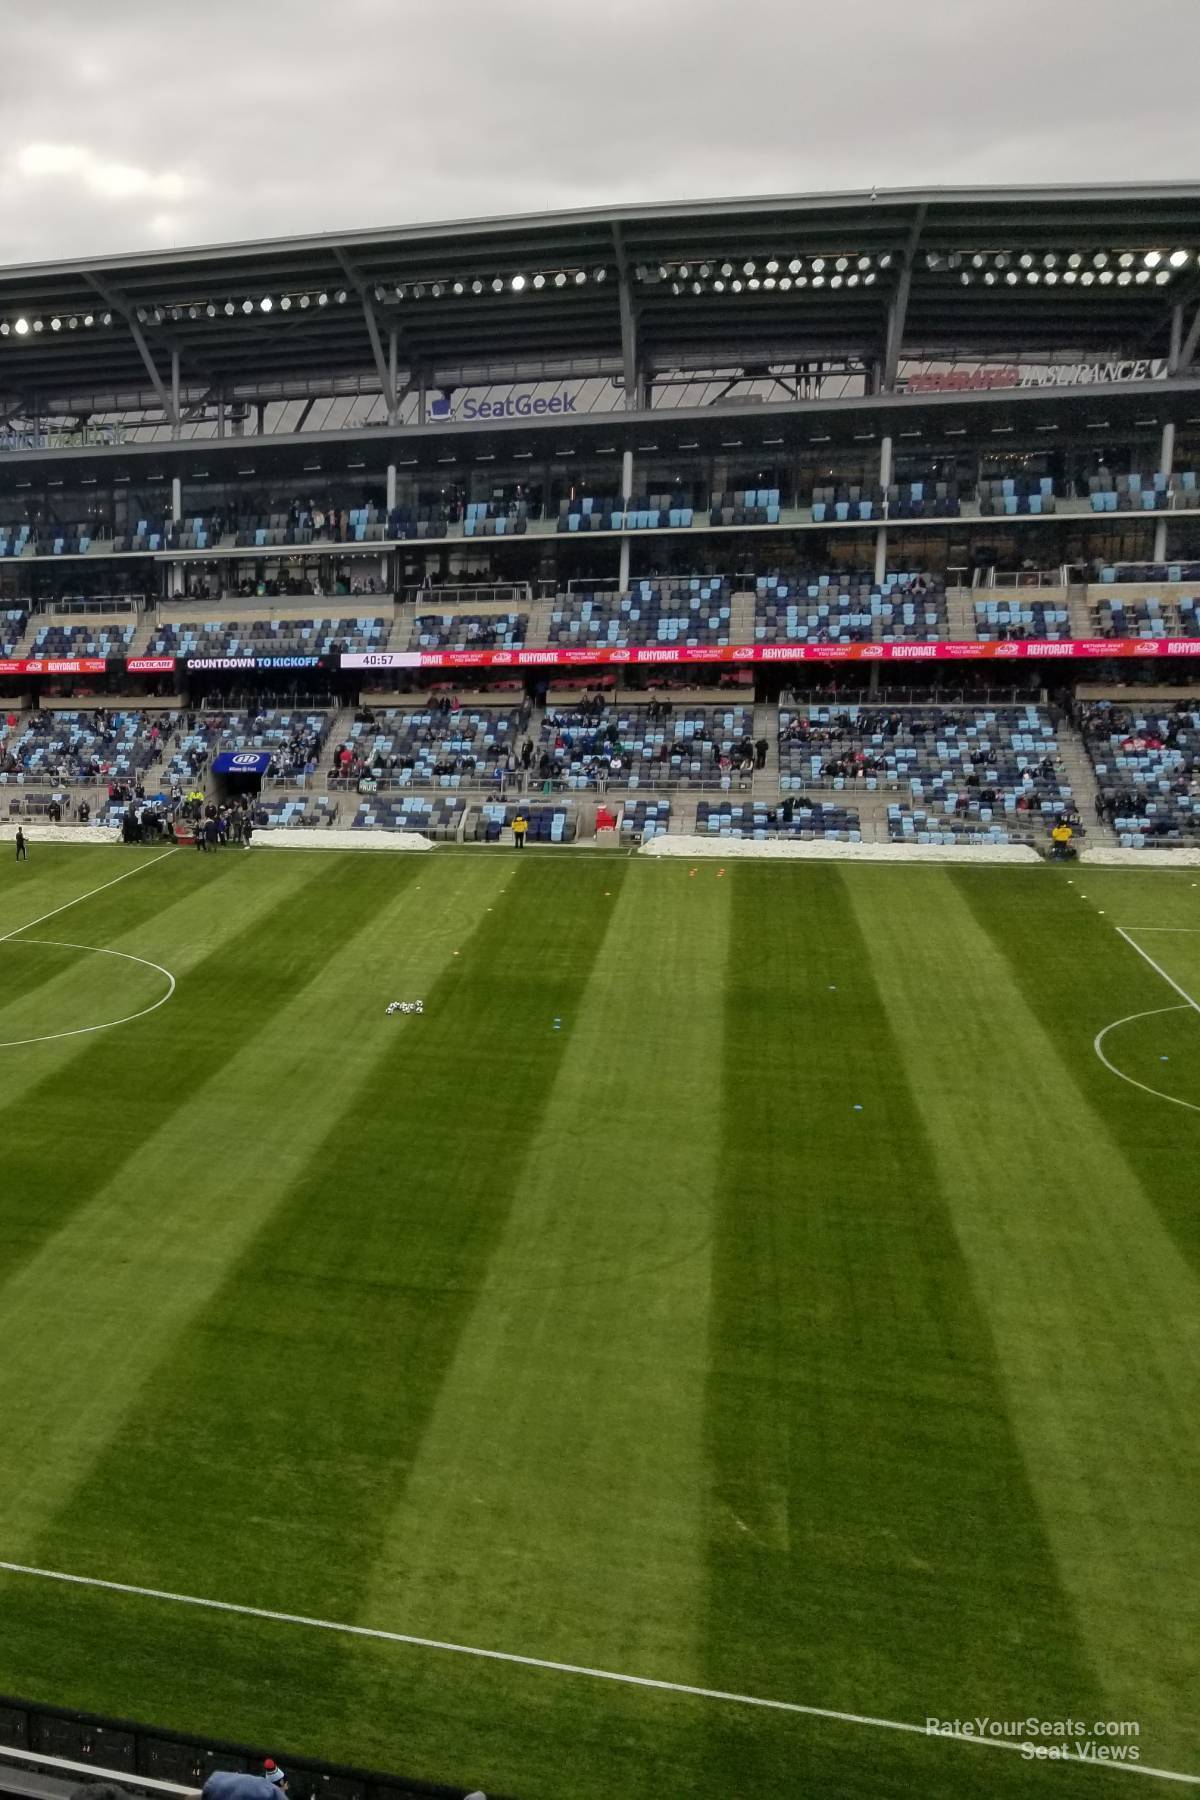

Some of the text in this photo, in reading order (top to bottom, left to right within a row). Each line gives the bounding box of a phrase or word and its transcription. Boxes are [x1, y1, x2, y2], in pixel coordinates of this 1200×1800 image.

[1020, 360, 1149, 387] INSURANCE
[463, 392, 576, 419] SeatGeek
[762, 648, 805, 658] REHYDRATE
[892, 646, 937, 656] REHYDRATE
[1027, 643, 1074, 655] REHYDRATE
[362, 656, 394, 665] 40:57
[519, 652, 559, 662] REHYDRATE
[638, 650, 679, 661] REHYDRATE
[48, 662, 80, 671] REHYDRATE
[187, 658, 255, 669] COUNTDOWN
[257, 658, 271, 668] TO
